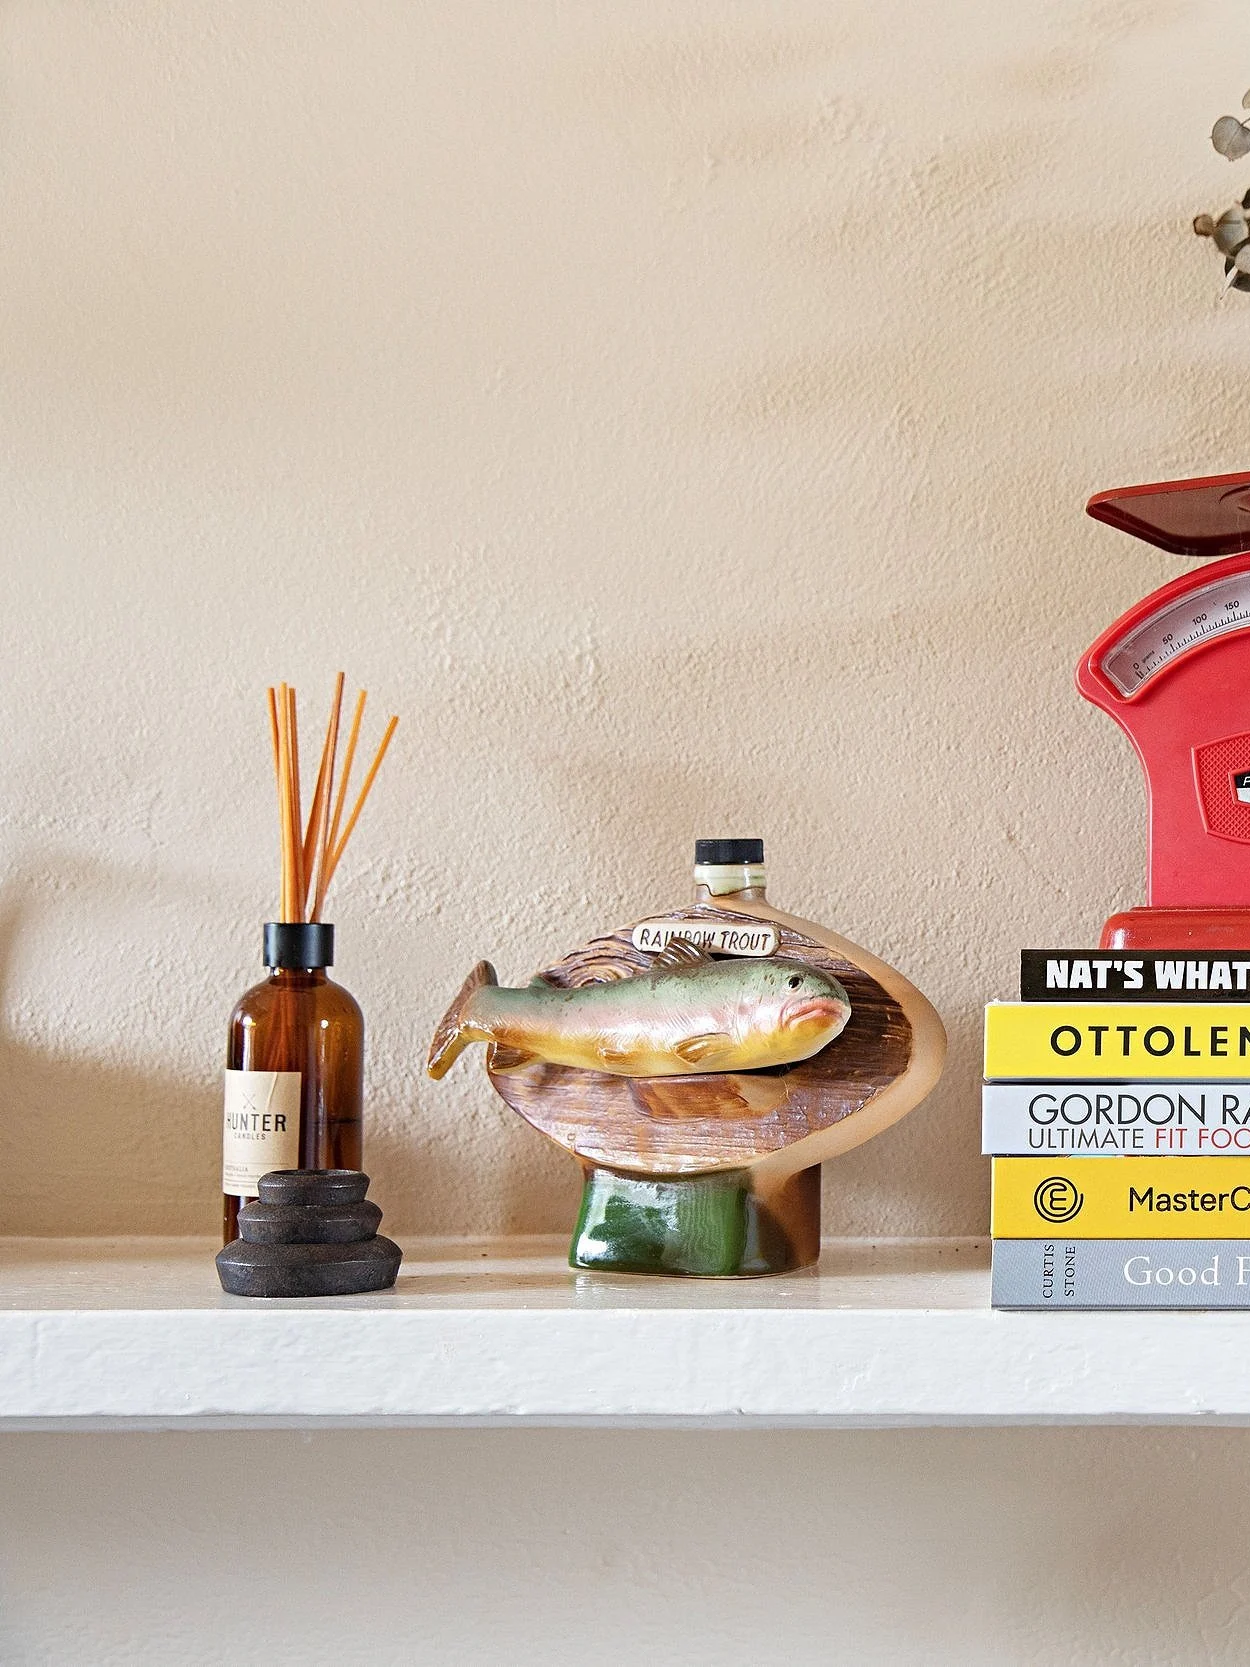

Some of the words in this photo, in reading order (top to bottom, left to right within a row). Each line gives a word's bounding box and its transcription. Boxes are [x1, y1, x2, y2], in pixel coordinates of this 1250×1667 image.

[1162, 633, 1174, 645] 50
[1192, 612, 1208, 626] 100
[1224, 600, 1240, 611] 150
[720, 930, 772, 951] TROUT
[1046, 959, 1144, 989] NAT'S
[1028, 1093, 1206, 1126] GORDON
[1028, 1127, 1144, 1149] ULTIMATE
[1155, 1127, 1188, 1149] FIT
[1042, 1243, 1055, 1299] CURTIS
[1064, 1246, 1076, 1297] STONE
[1123, 1255, 1220, 1286] Good
